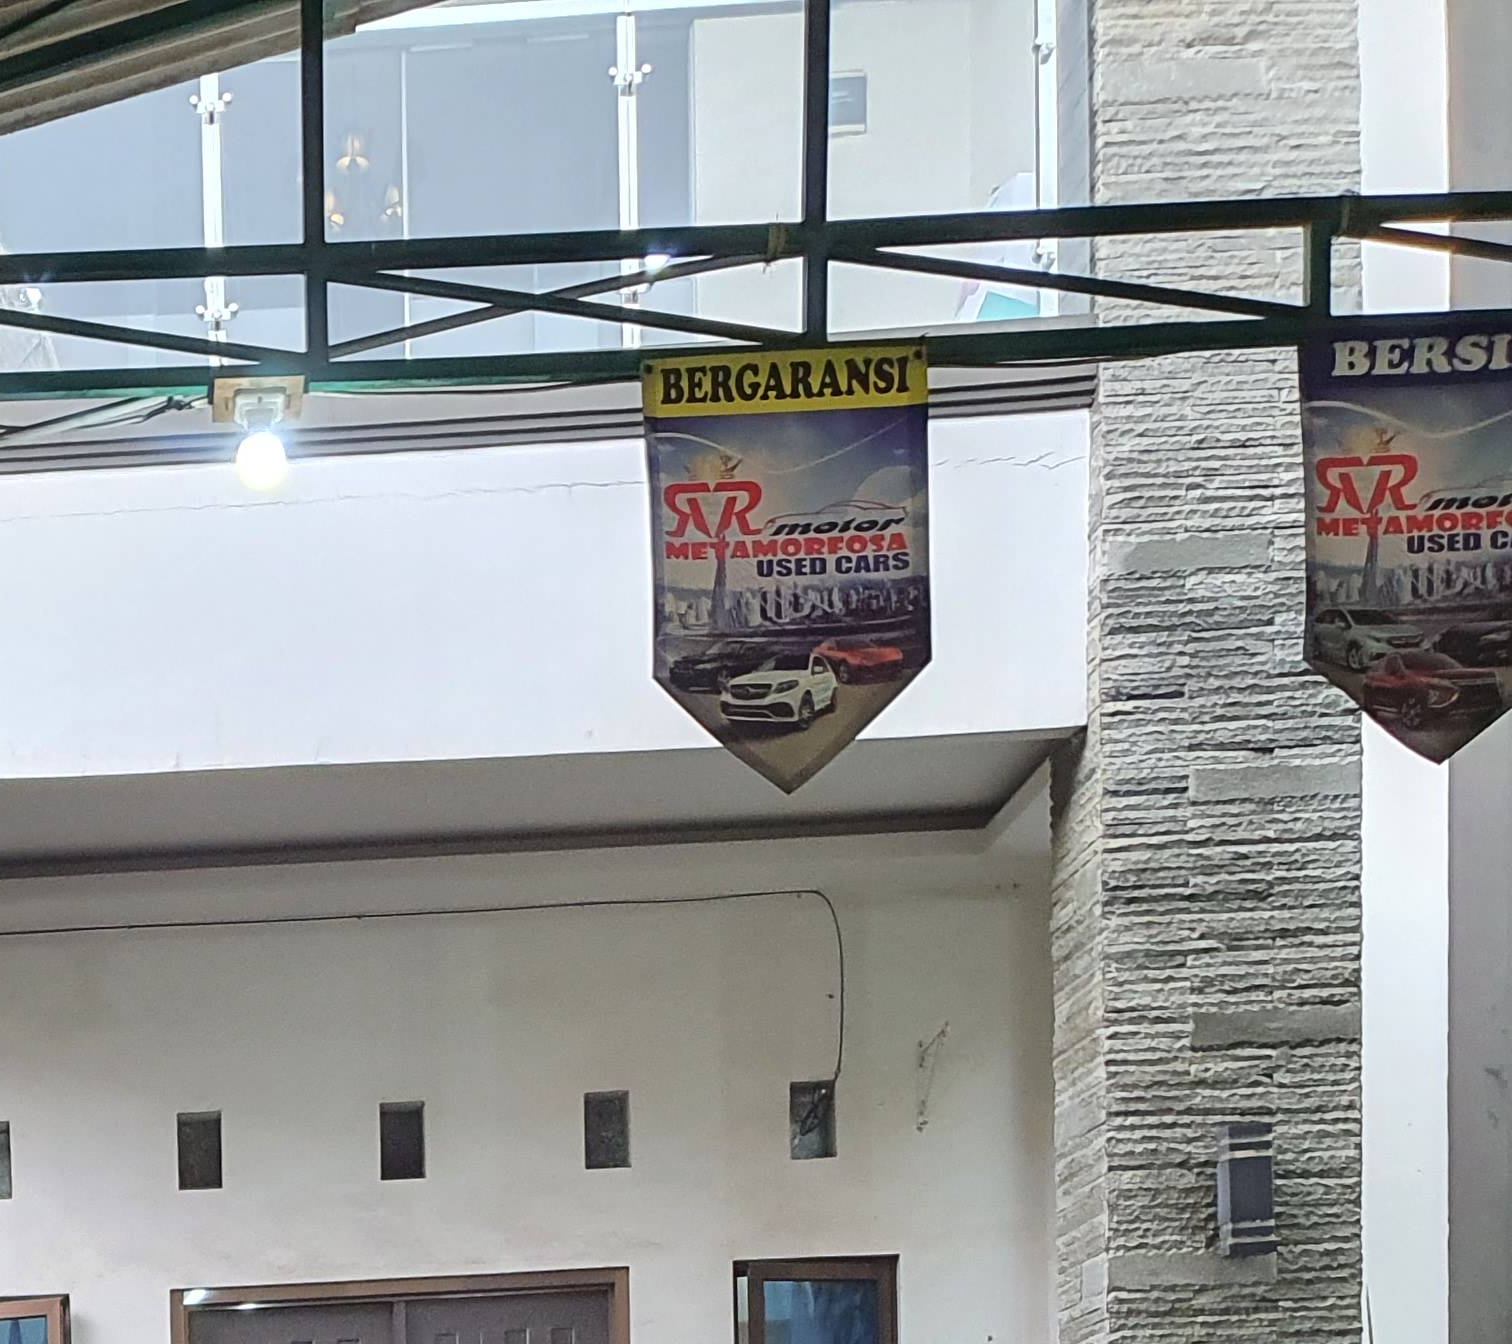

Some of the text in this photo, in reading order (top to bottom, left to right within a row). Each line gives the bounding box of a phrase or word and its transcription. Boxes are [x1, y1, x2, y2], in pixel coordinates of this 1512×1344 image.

[660, 356, 910, 405] BERGARANSI
[768, 516, 906, 537] motor
[664, 532, 908, 560] METAMORFOSA
[1406, 532, 1482, 555] USED
[756, 550, 911, 578] USED CARS
